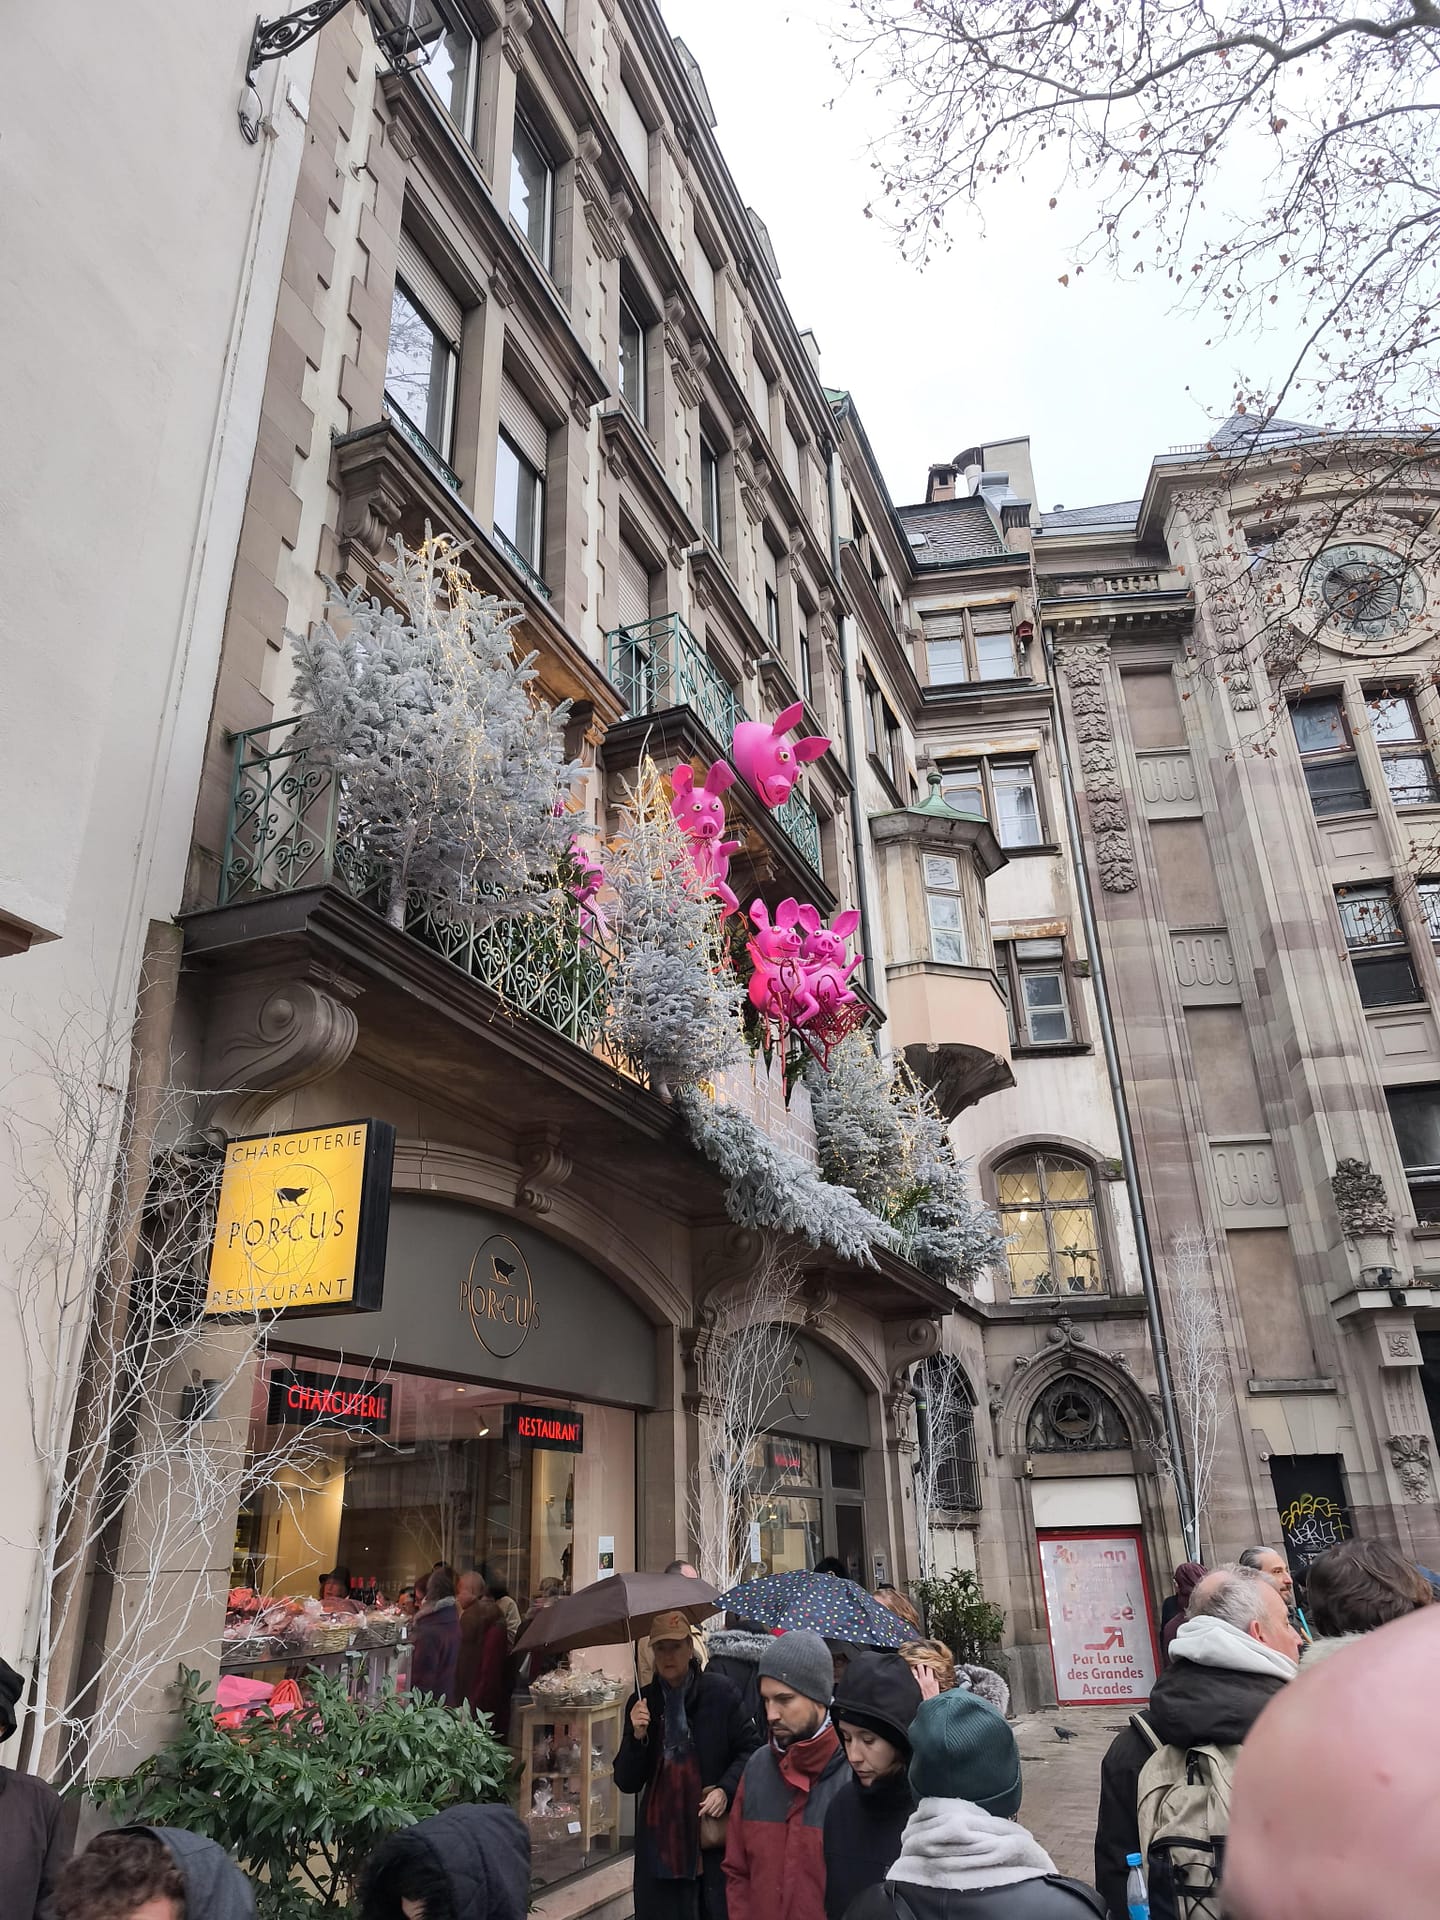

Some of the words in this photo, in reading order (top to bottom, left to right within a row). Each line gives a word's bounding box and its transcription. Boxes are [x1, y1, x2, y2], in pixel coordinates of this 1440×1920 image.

[231, 1130, 362, 1163] CHARCUTERIE
[229, 1209, 345, 1249] PORCUS
[211, 1278, 348, 1306] RESTAURANT
[459, 1280, 541, 1329] PORCUS
[287, 1384, 387, 1419] CHARCUTERIE
[518, 1416, 580, 1441] RESTAURANT
[1072, 1653, 1094, 1665] Par
[1097, 1652, 1111, 1664] la
[1113, 1655, 1134, 1664] rue
[1067, 1668, 1089, 1680] des
[1091, 1666, 1144, 1680] Grandes
[1082, 1682, 1133, 1695] Arcades
